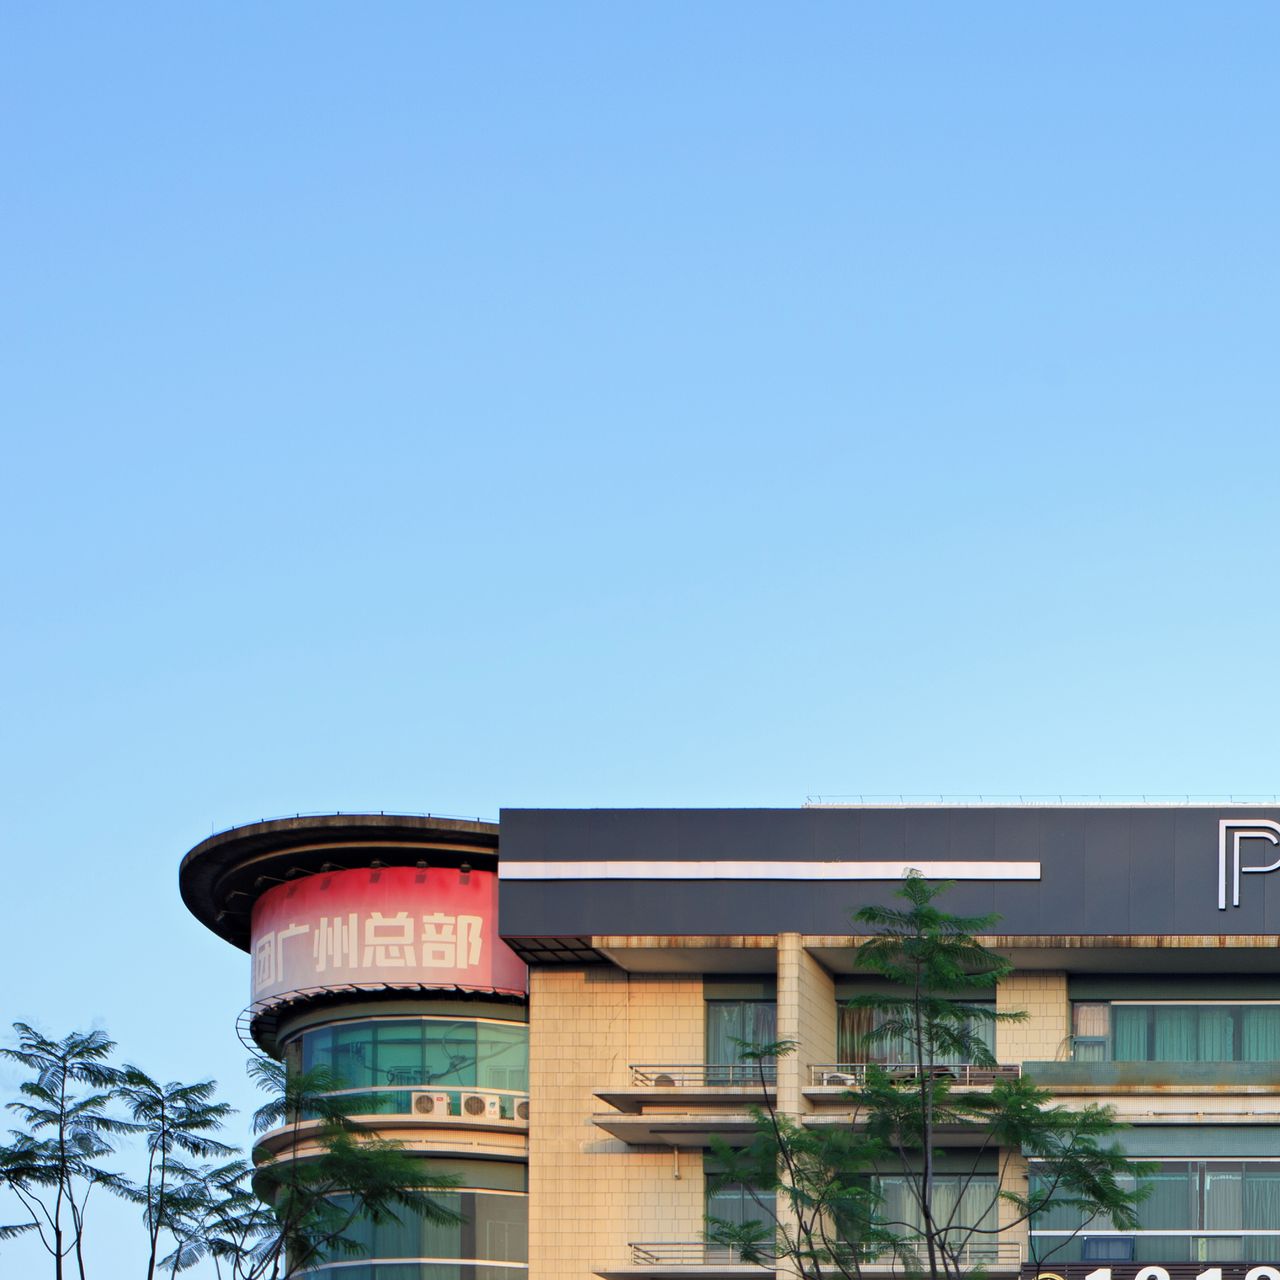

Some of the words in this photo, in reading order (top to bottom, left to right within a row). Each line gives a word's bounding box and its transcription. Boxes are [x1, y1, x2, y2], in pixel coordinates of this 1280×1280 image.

[255, 911, 483, 991] 团广州总部
